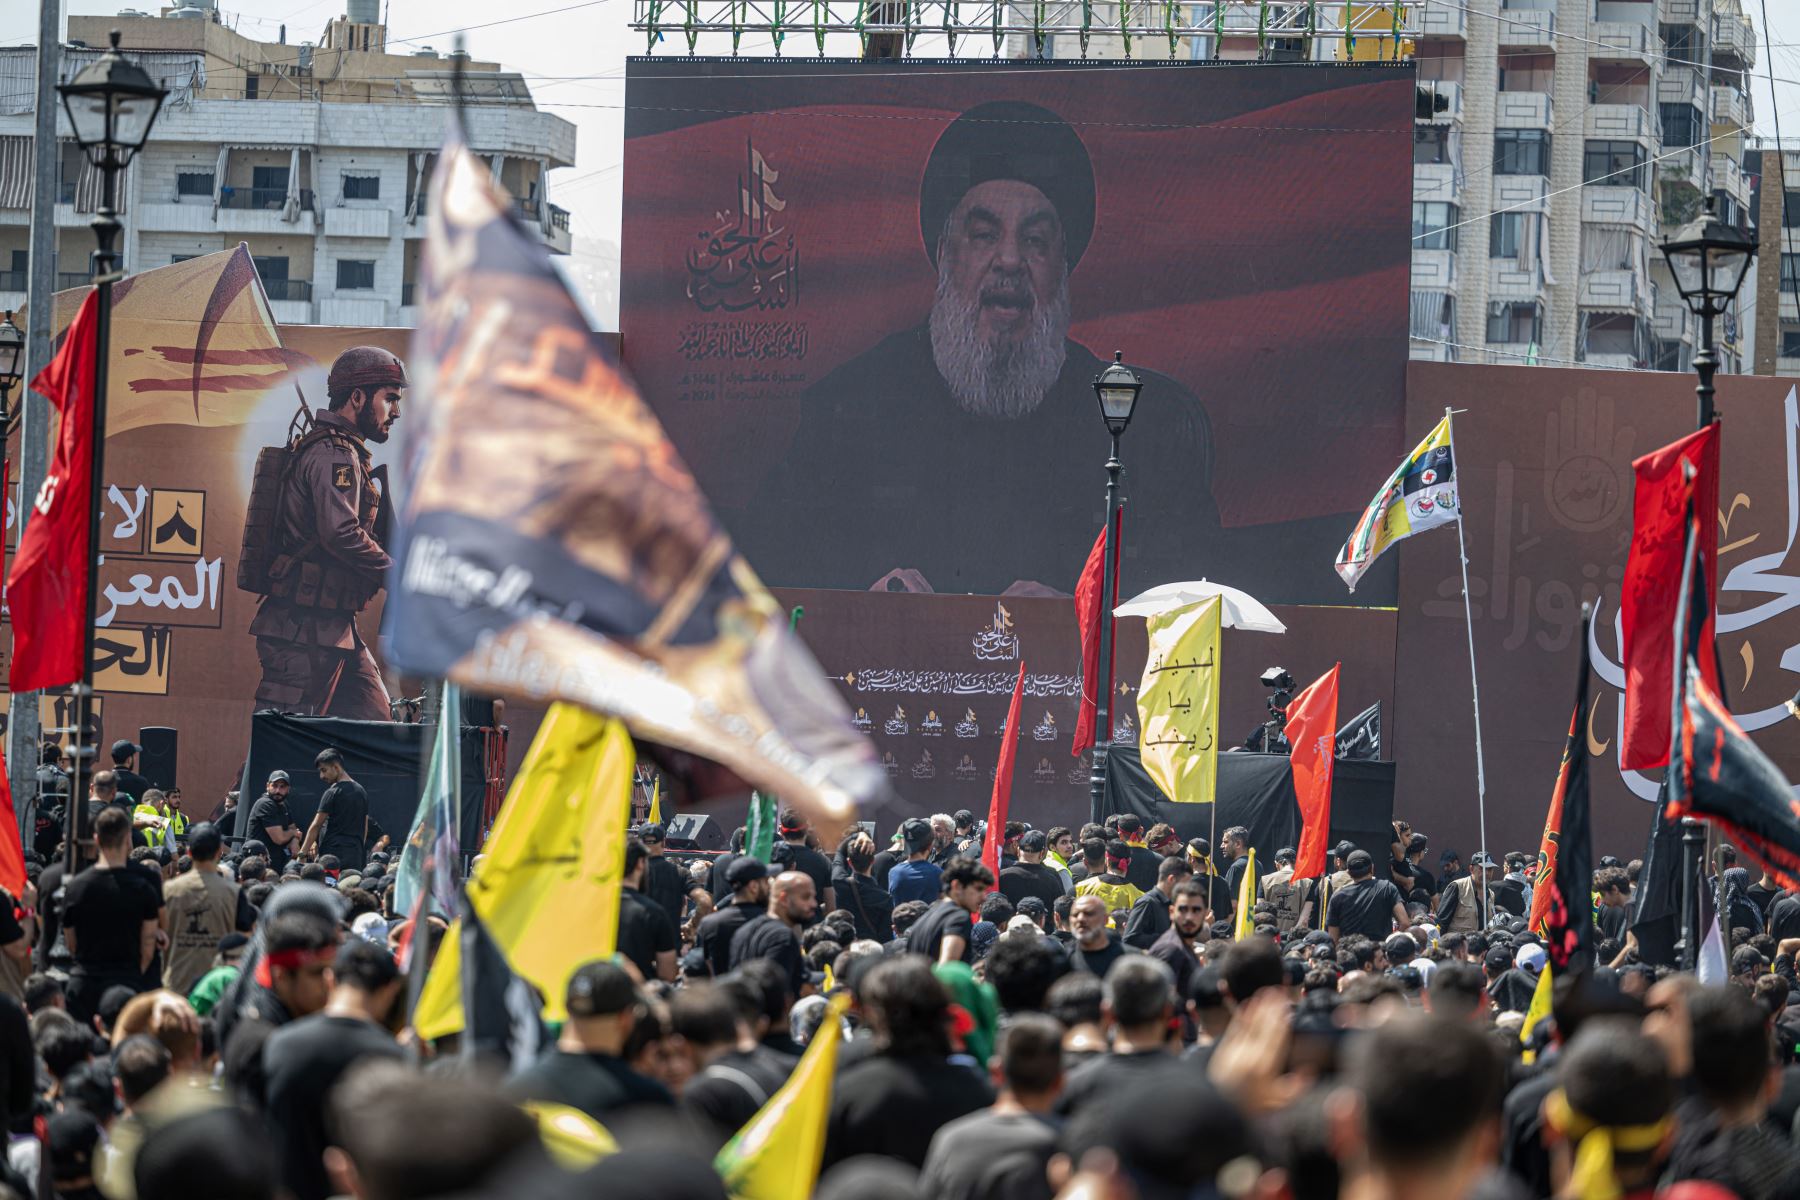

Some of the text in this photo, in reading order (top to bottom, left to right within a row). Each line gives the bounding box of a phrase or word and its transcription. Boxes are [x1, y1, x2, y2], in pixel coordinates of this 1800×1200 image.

[107, 484, 149, 539] لا
[1149, 645, 1214, 676] لبيك
[1168, 690, 1191, 715] يا
[1144, 726, 1213, 752] زينب
